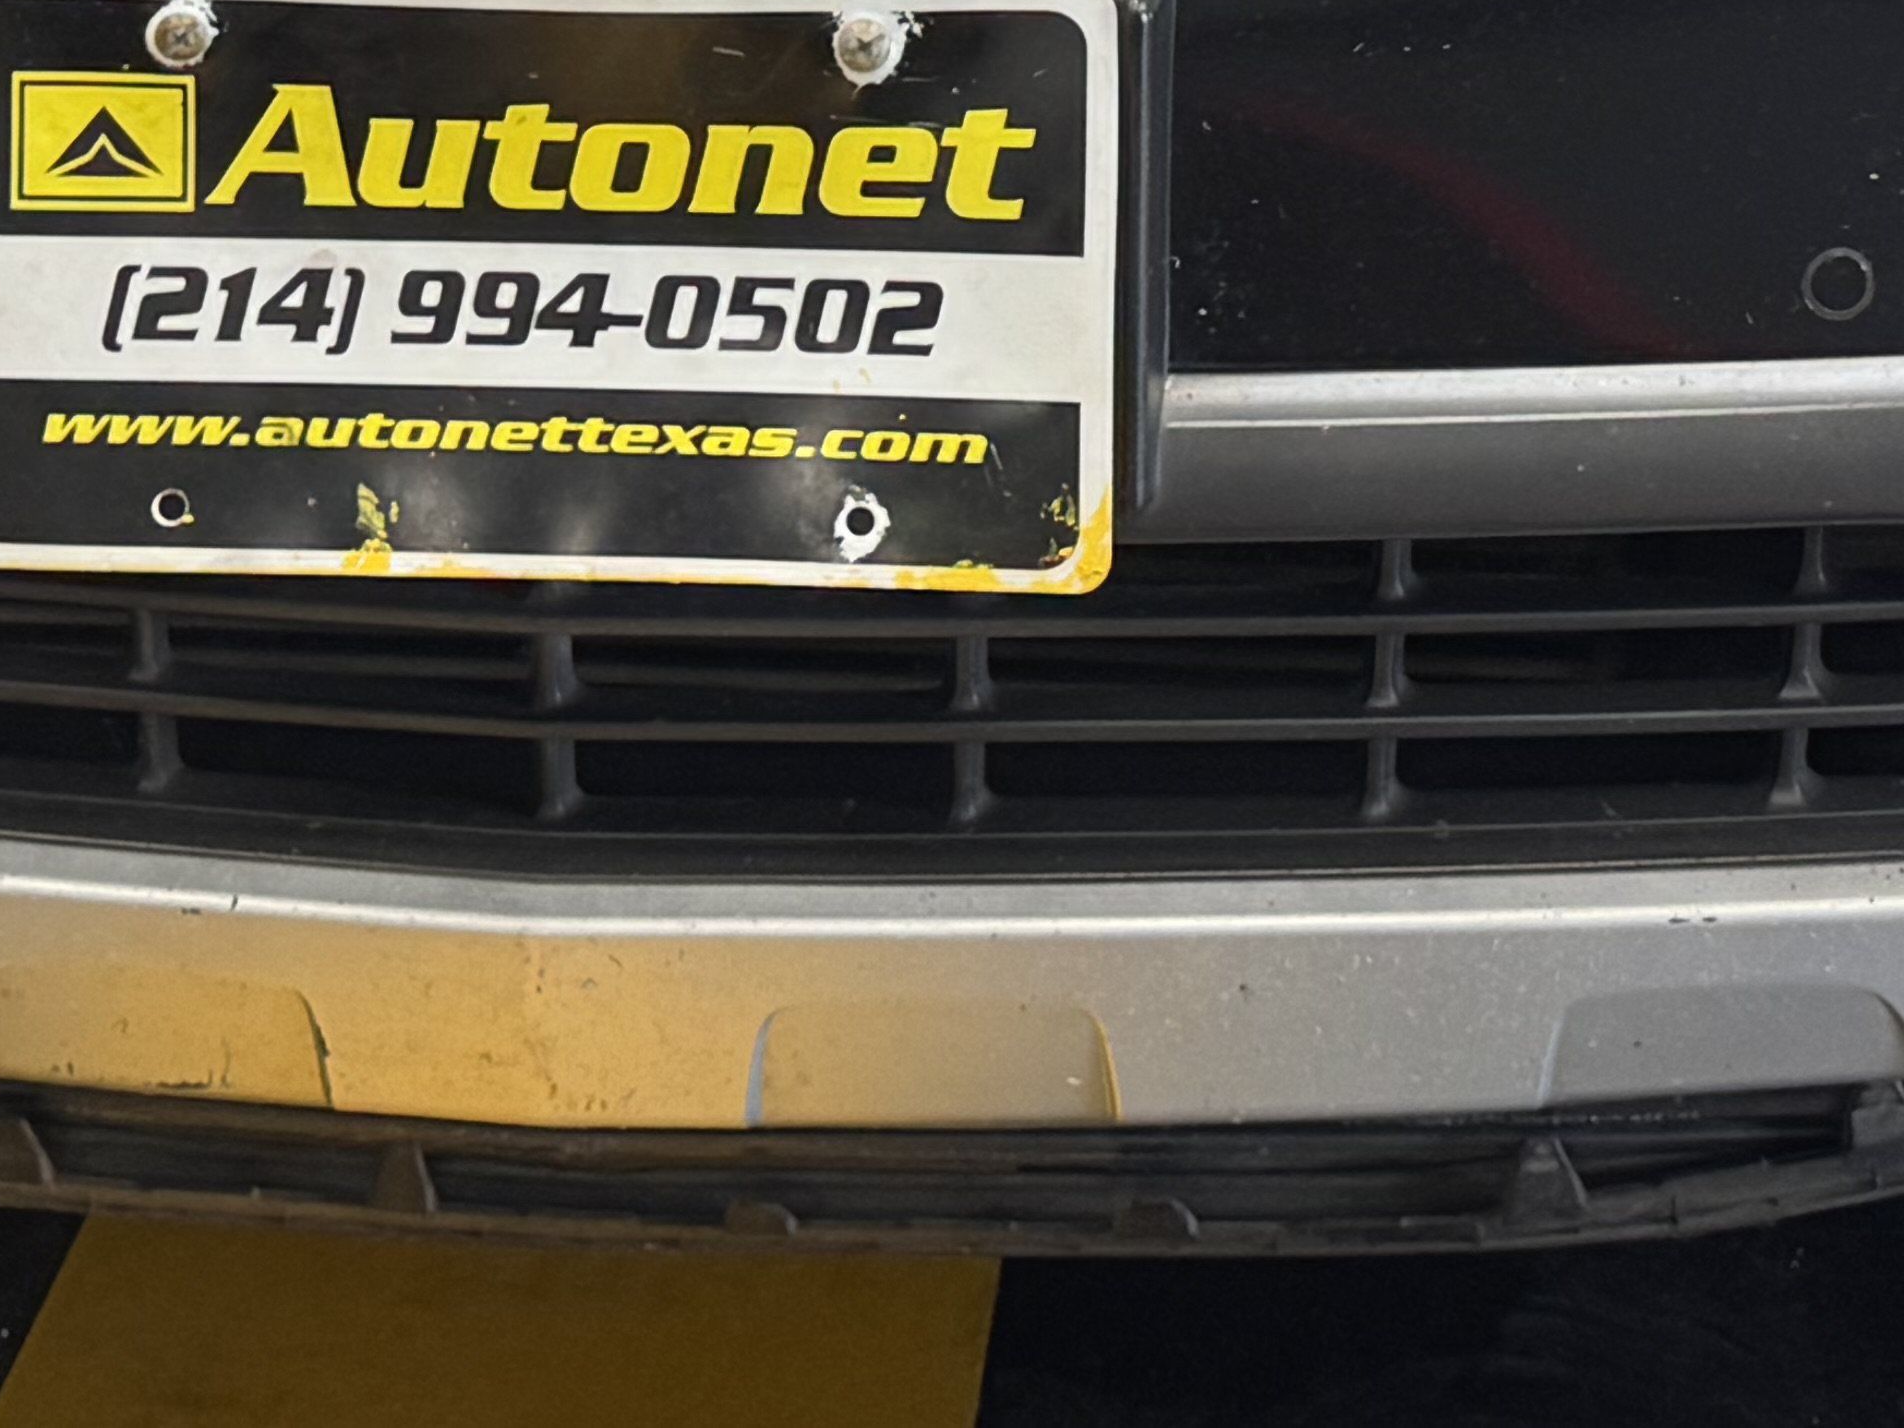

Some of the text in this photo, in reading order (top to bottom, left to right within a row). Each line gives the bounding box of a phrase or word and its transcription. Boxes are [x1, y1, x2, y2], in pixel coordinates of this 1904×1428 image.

[206, 82, 1039, 222] Autonet
[100, 264, 946, 358] (214) 994-0502
[42, 411, 990, 466] www.autonettexas.com
